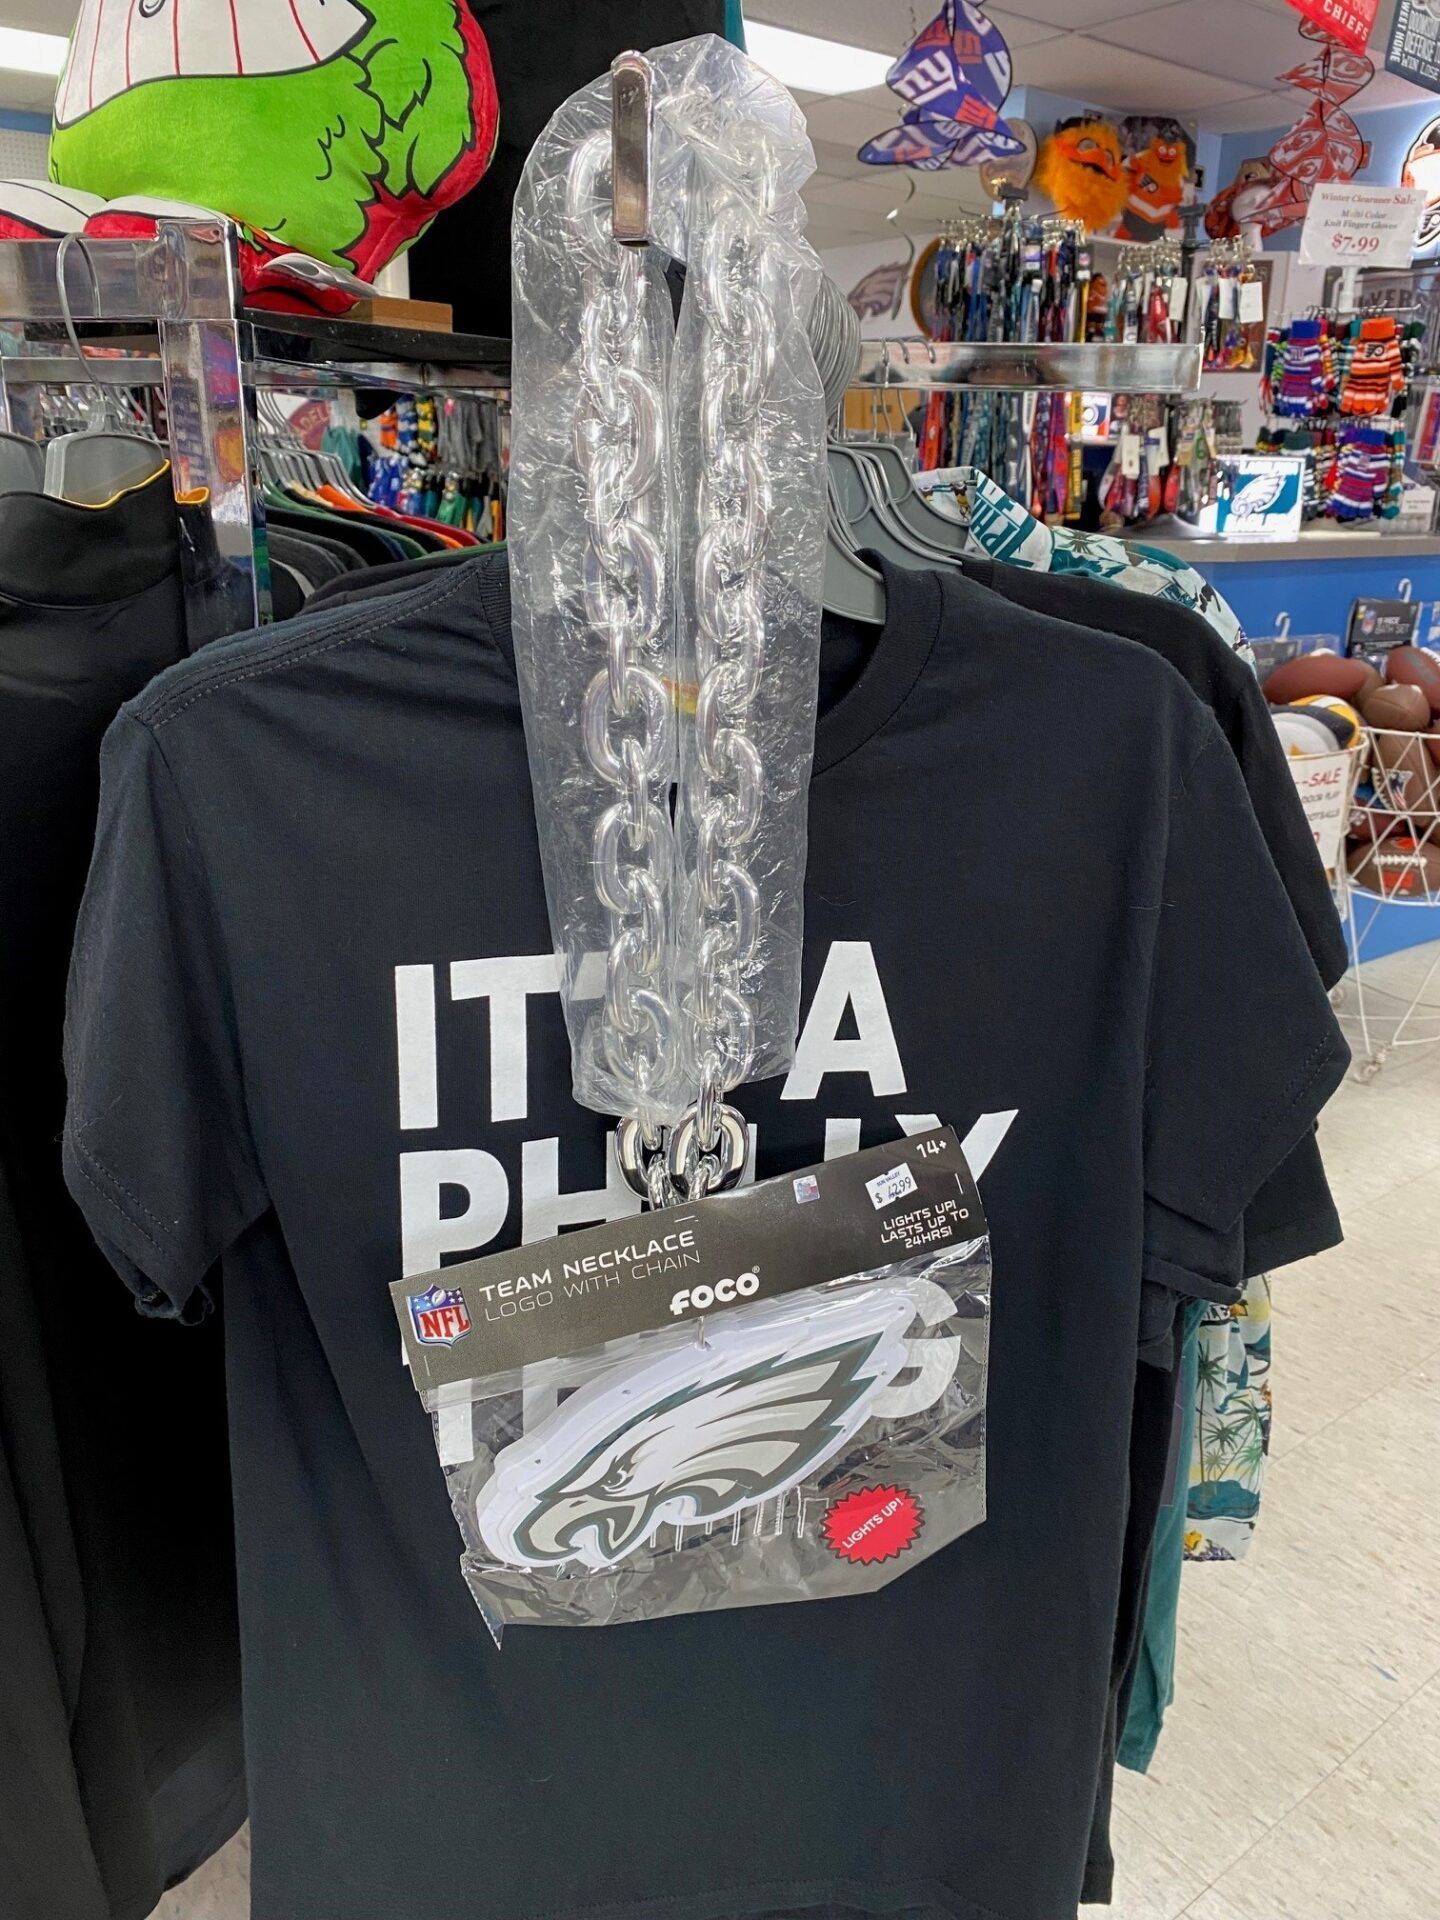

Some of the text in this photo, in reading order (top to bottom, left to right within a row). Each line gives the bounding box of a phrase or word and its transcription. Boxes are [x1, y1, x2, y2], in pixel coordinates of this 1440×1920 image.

[1323, 1, 1369, 41] CHIEFS
[1389, 1, 1411, 63] WEET HOME
[1321, 191, 1351, 201] Winter
[1392, 193, 1416, 205] Sale
[1331, 232, 1380, 253] $7.99
[1343, 220, 1370, 230] Finger
[781, 940, 907, 1100] A
[916, 1139, 947, 1159] 14+
[880, 1207, 969, 1244] LASTS UP TO
[883, 1199, 957, 1231] LIGHTS UP!
[904, 1225, 953, 1249] 24HRS!
[479, 1229, 696, 1302] TEAM NECKLACE
[485, 1249, 701, 1322] LOGO WITH CHAIN
[418, 1306, 471, 1339] NFL
[841, 1497, 904, 1549] LIGHTS UP!
